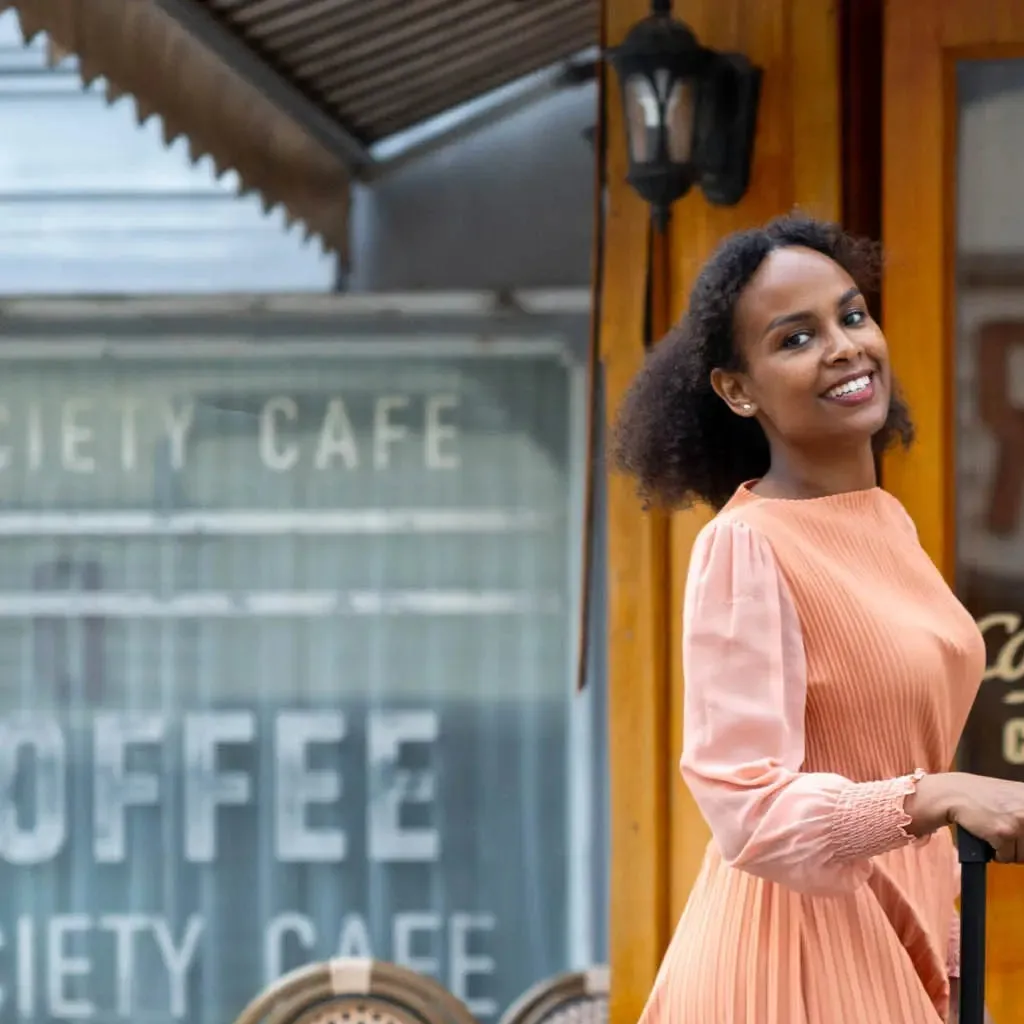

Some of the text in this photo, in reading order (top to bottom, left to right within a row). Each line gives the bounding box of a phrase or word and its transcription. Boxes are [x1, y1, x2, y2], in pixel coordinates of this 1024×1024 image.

[0, 394, 461, 471] IETY CAFE
[0, 709, 440, 865] OFFEE
[0, 913, 204, 1019] IETY
